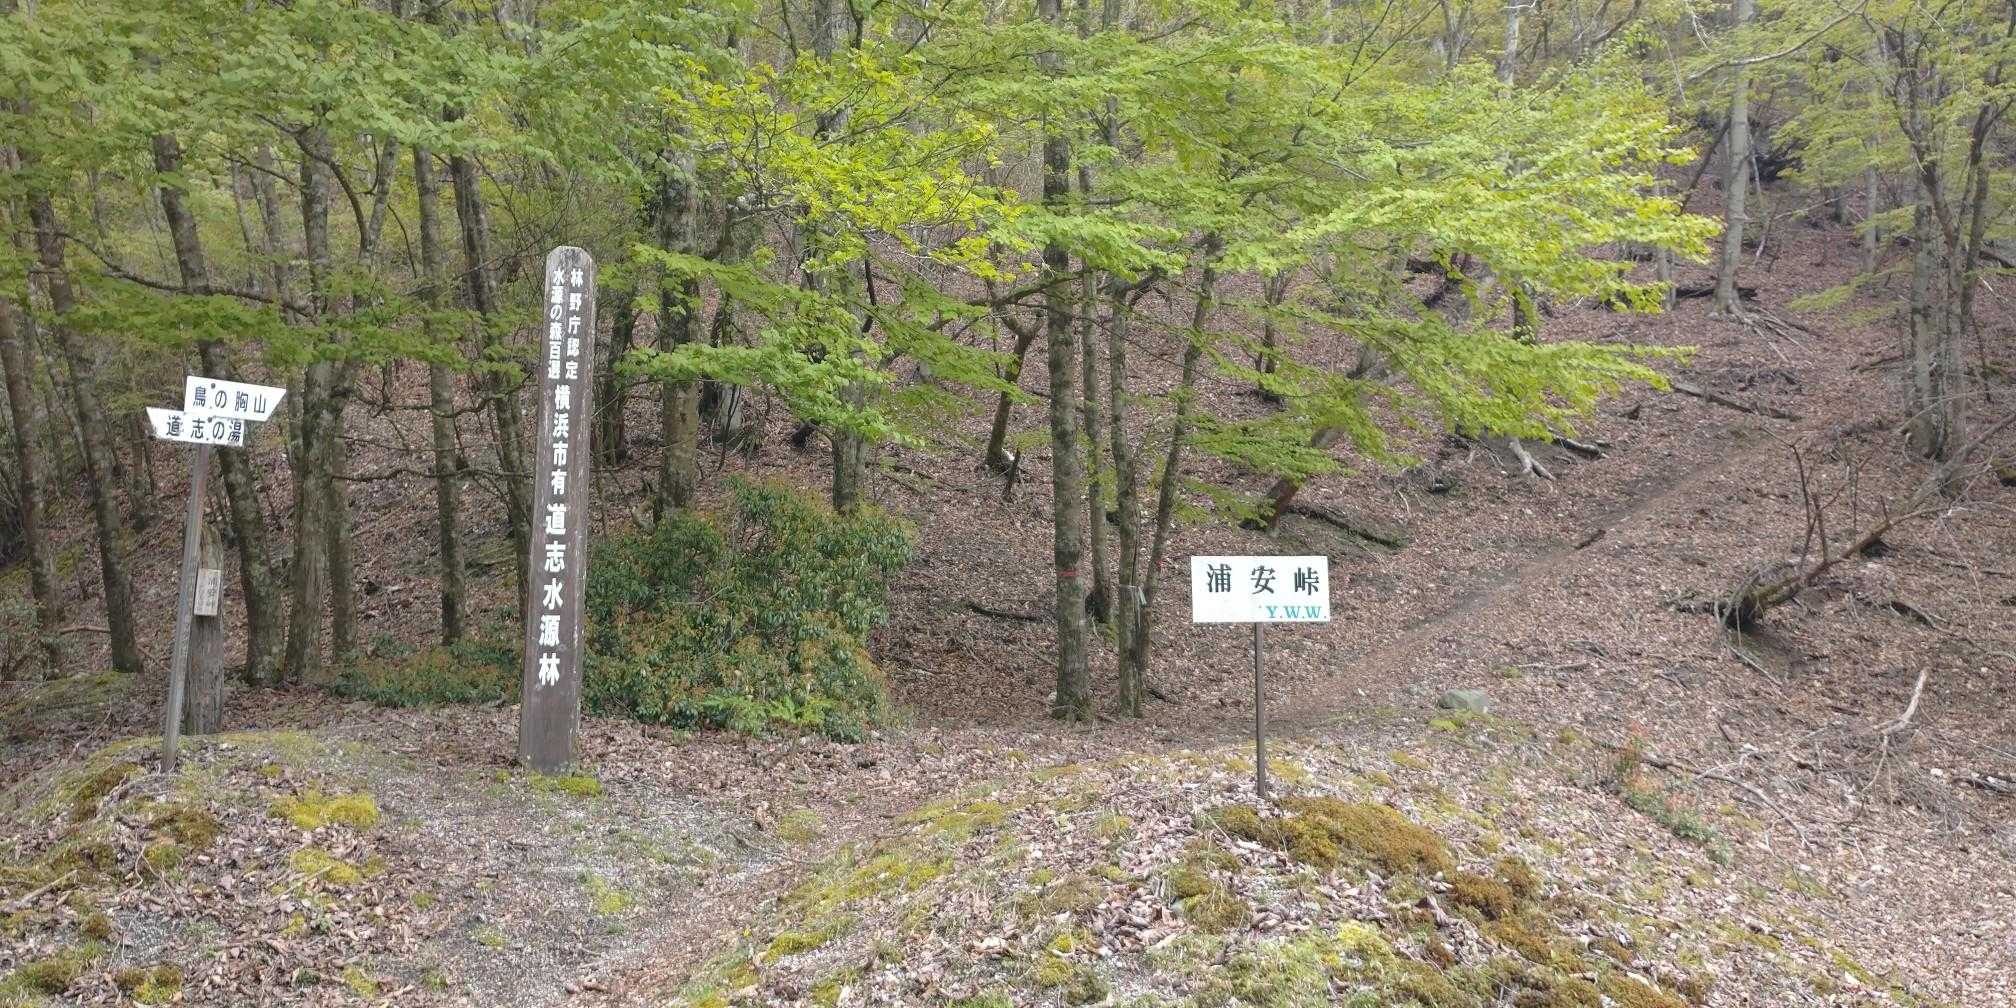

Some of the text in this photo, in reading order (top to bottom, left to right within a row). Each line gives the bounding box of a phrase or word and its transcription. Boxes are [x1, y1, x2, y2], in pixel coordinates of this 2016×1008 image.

[547, 267, 565, 380] 水源の森百選
[565, 268, 584, 380] 林野庁認定
[193, 386, 267, 413] 鳥の胸山
[165, 415, 242, 442] 道志の湯
[1206, 563, 1320, 596] 浦安峠
[1265, 605, 1327, 619] Y.W.W.
